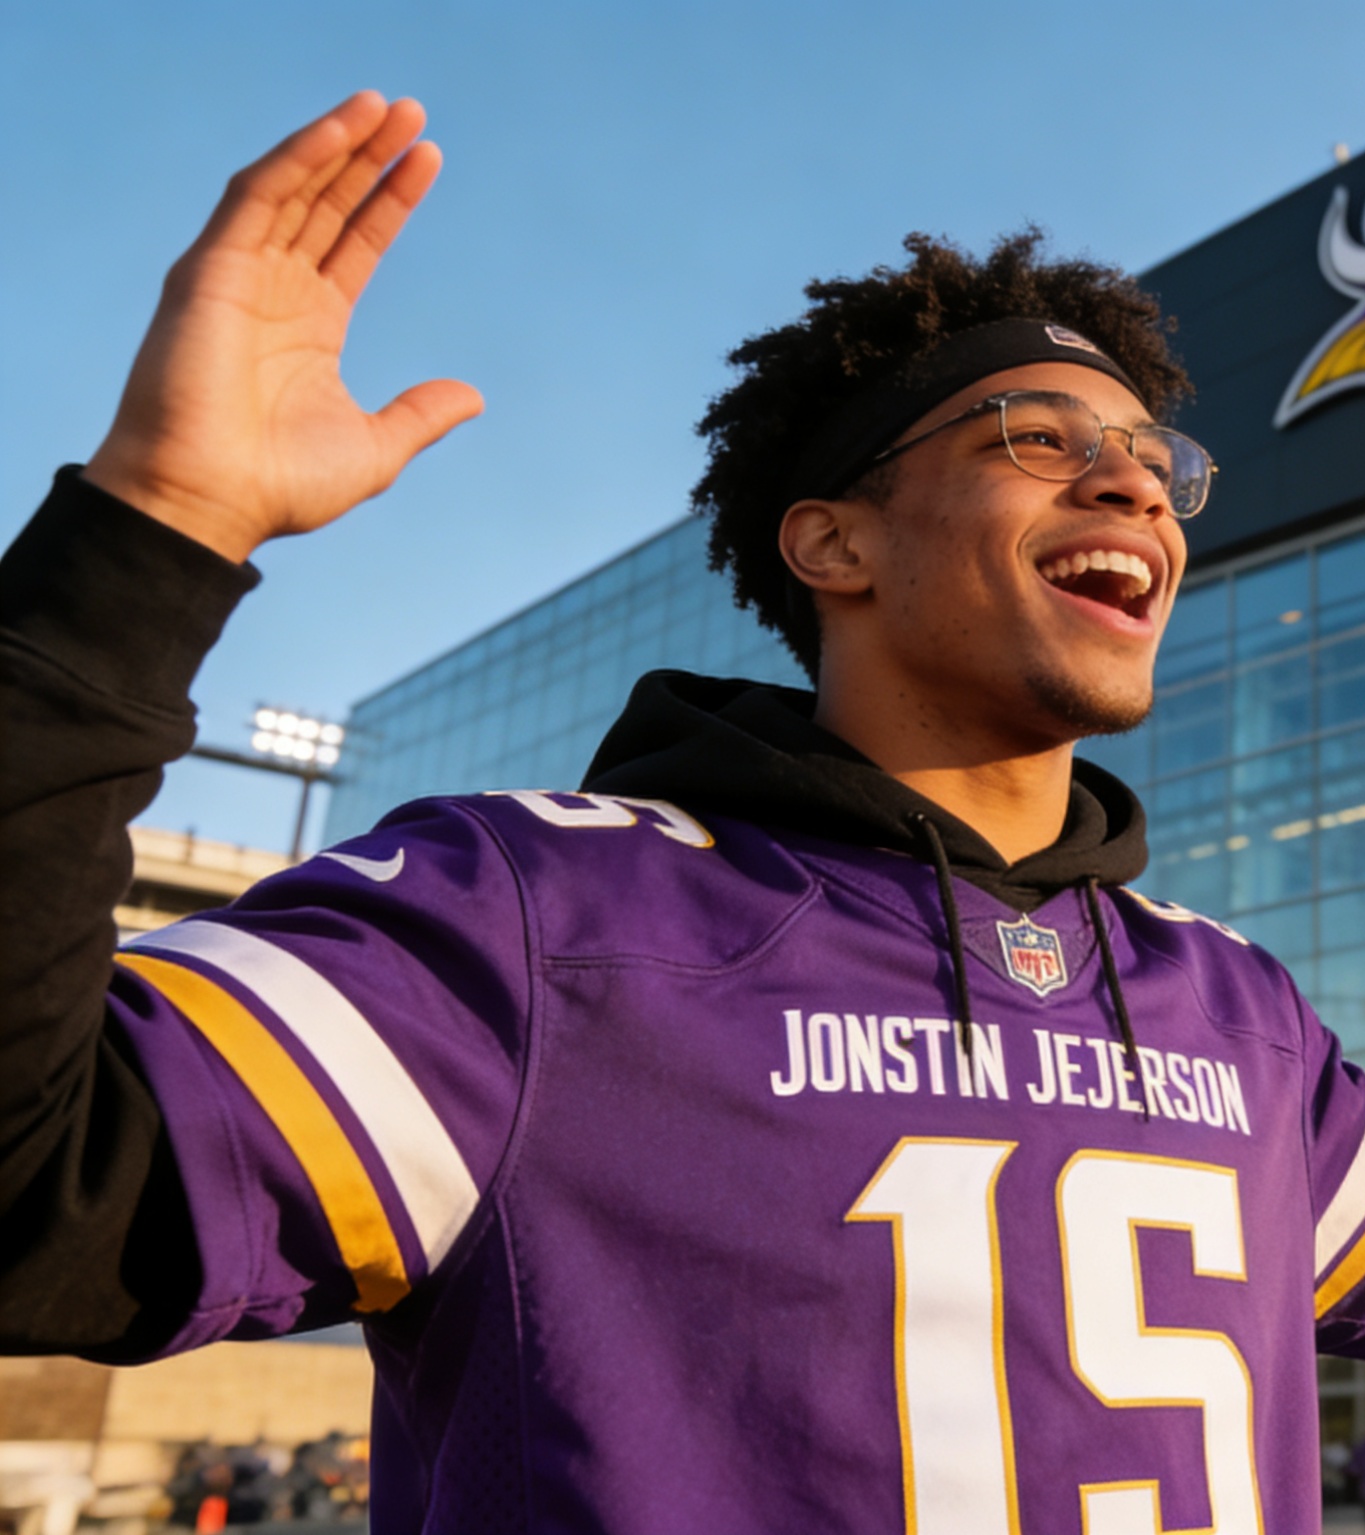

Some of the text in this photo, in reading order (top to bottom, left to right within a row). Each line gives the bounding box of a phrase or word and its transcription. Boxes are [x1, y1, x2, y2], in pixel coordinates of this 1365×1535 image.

[770, 1009, 1251, 1136] JONSTIN JEJERSON
[843, 1136, 1265, 1535] 15
